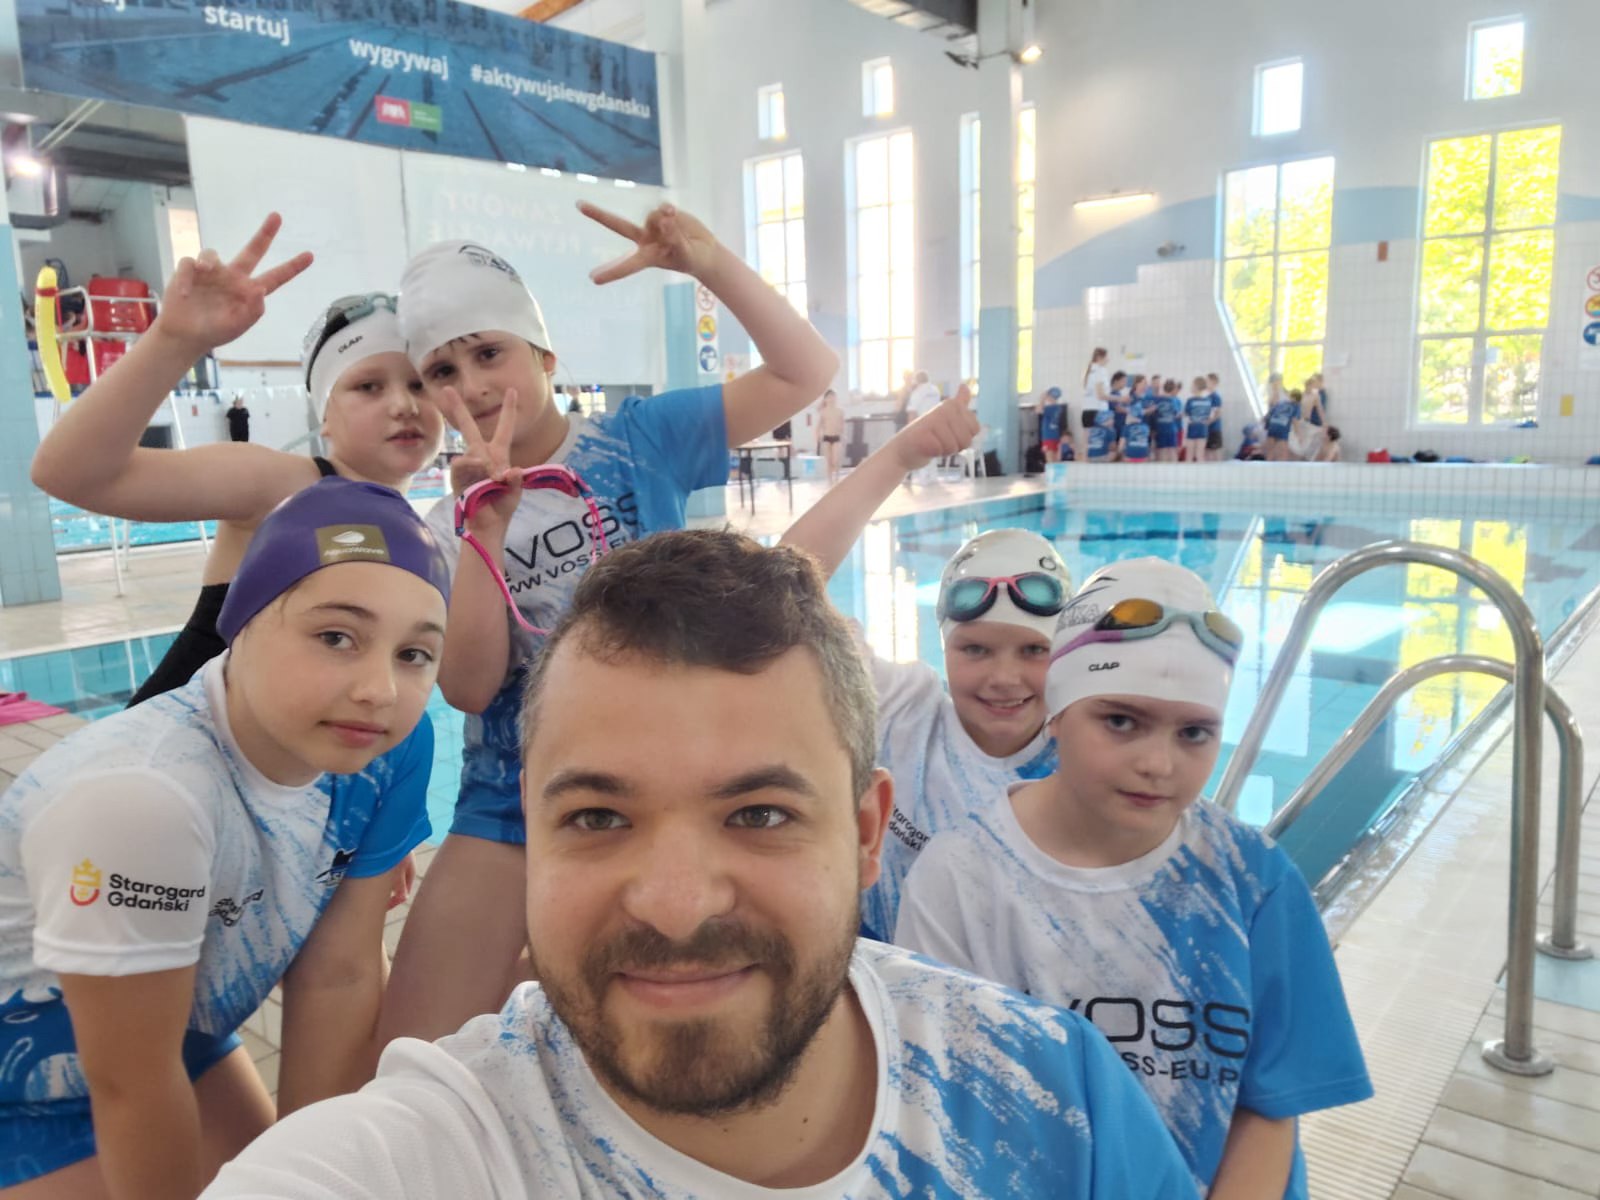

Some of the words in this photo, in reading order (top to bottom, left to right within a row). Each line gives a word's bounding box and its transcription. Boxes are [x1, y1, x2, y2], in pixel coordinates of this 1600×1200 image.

[204, 5, 290, 46] startuj
[349, 38, 449, 81] wygrywaj
[470, 64, 651, 119] #aktywujsiewgdansku
[1088, 662, 1120, 672] CLAP
[891, 803, 931, 842] tarogar
[107, 891, 190, 912] Gdański
[109, 873, 206, 900] Starogard
[1070, 997, 1249, 1059] OSS
